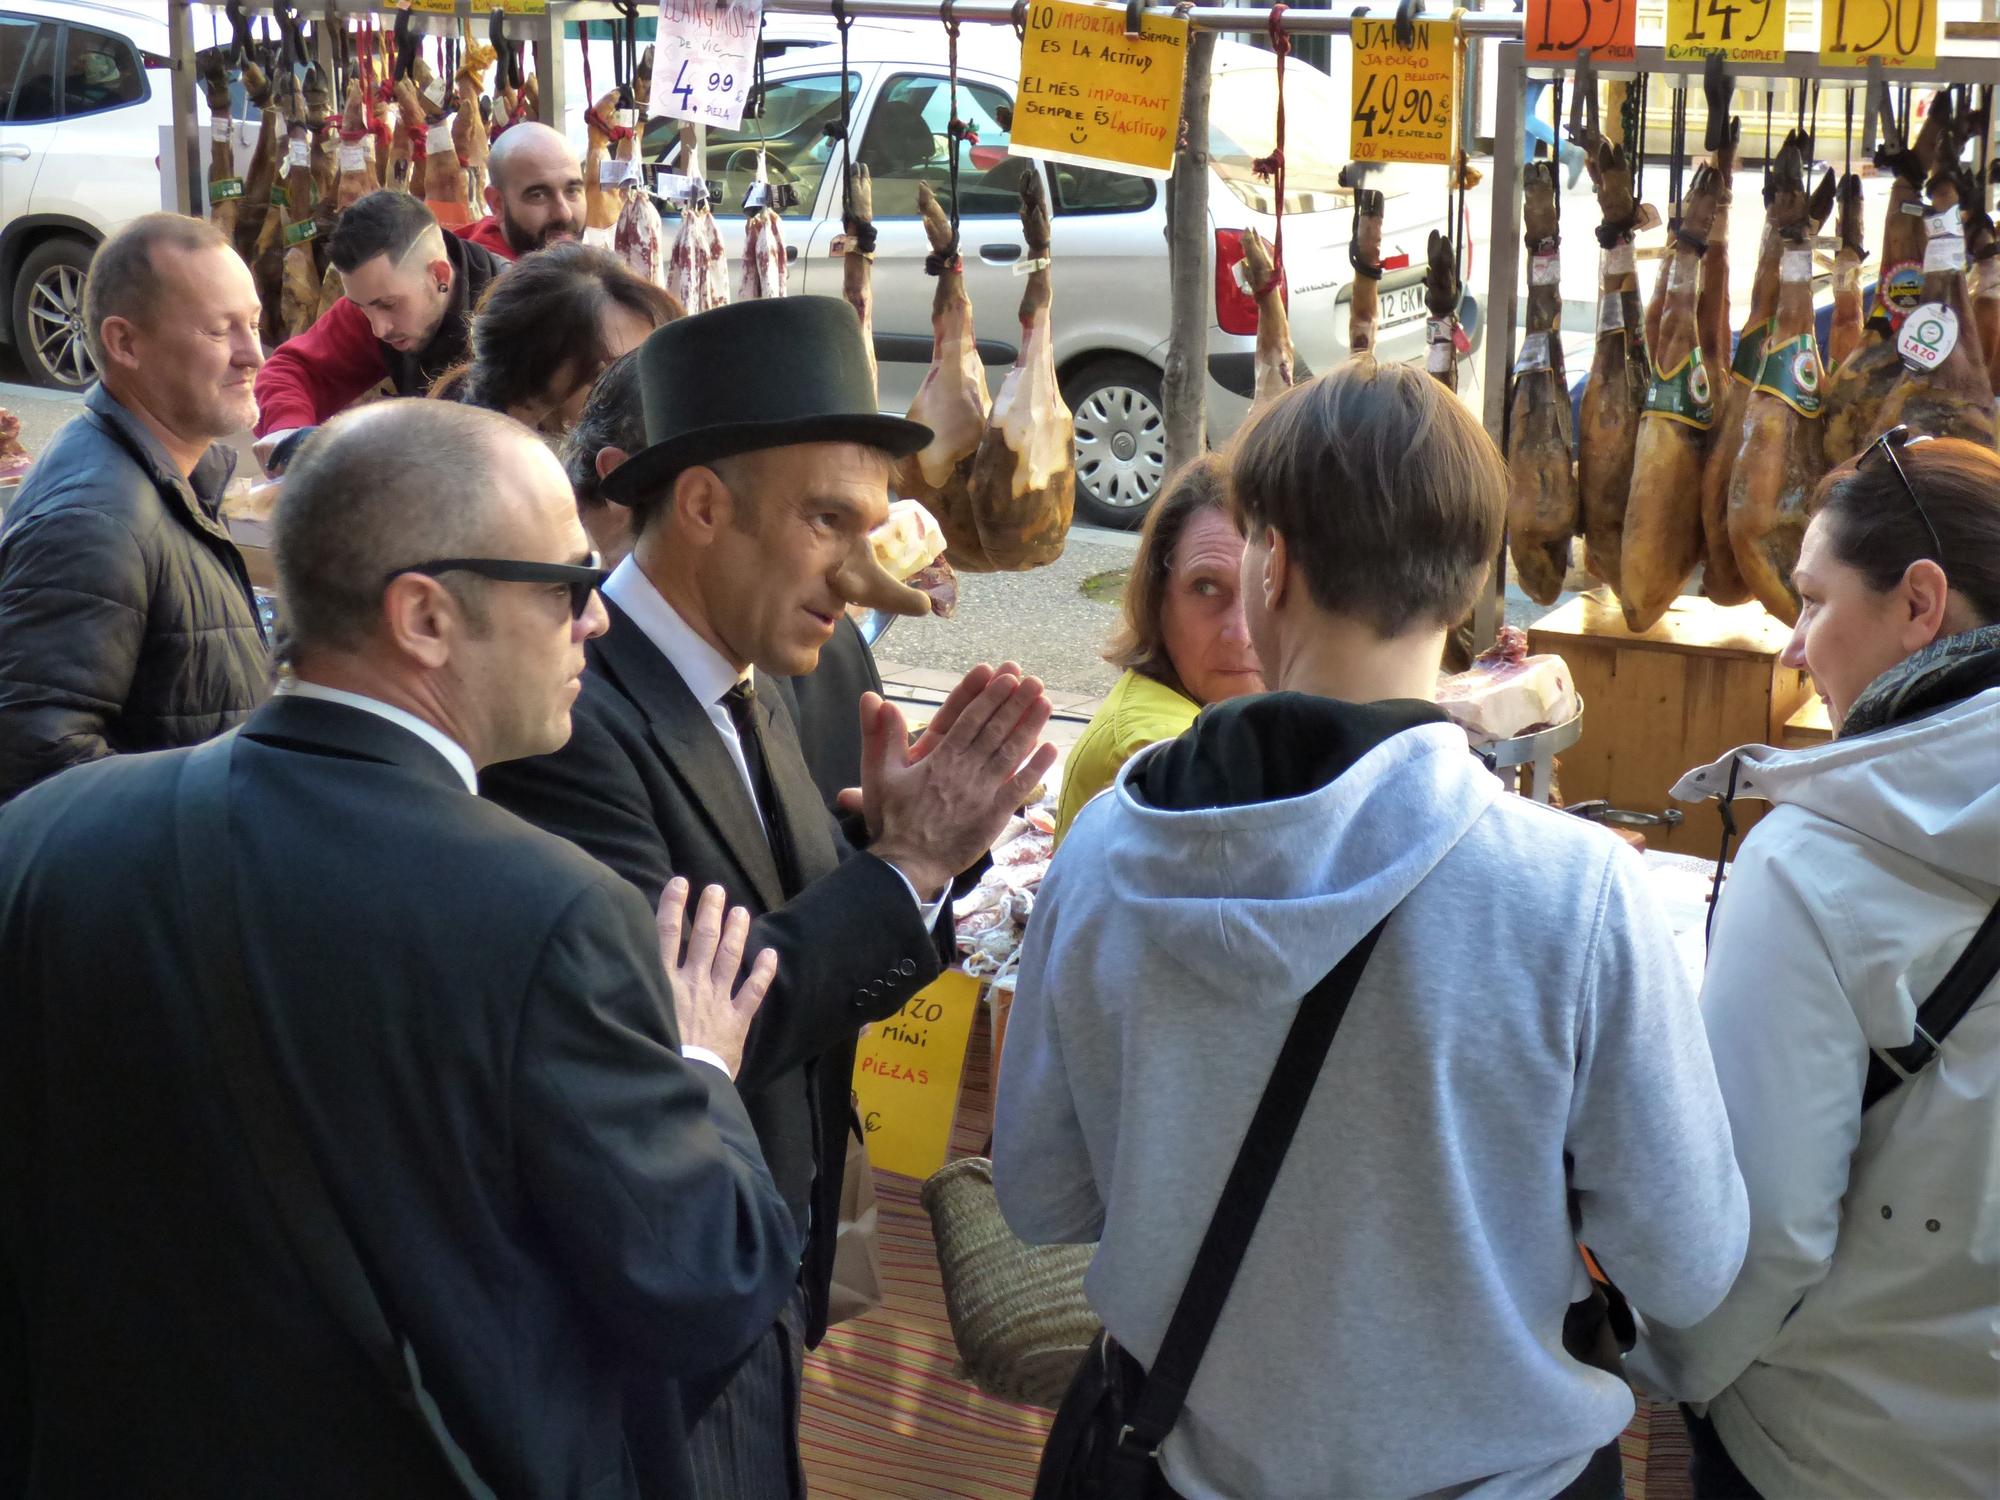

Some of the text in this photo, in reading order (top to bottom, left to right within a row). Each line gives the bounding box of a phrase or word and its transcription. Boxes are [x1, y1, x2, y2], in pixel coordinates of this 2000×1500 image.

[1032, 6, 1179, 46] LO IMPORTAN SIEMPRE
[677, 36, 722, 52] DE VIC
[1732, 48, 1780, 60] COMPLET
[1041, 40, 1153, 73] ES LA ACTITUD
[1361, 54, 1429, 68] JABUGO
[1023, 77, 1043, 93] EL
[1088, 83, 1170, 111] IMPORTANT
[1026, 101, 1085, 121] SEMPRE
[1397, 129, 1443, 139] ENTERO
[1382, 149, 1446, 161] DESCUENTO
[1381, 295, 1394, 319] 12
[1904, 340, 1936, 361] LAZO
[865, 1111, 881, 1133] €
